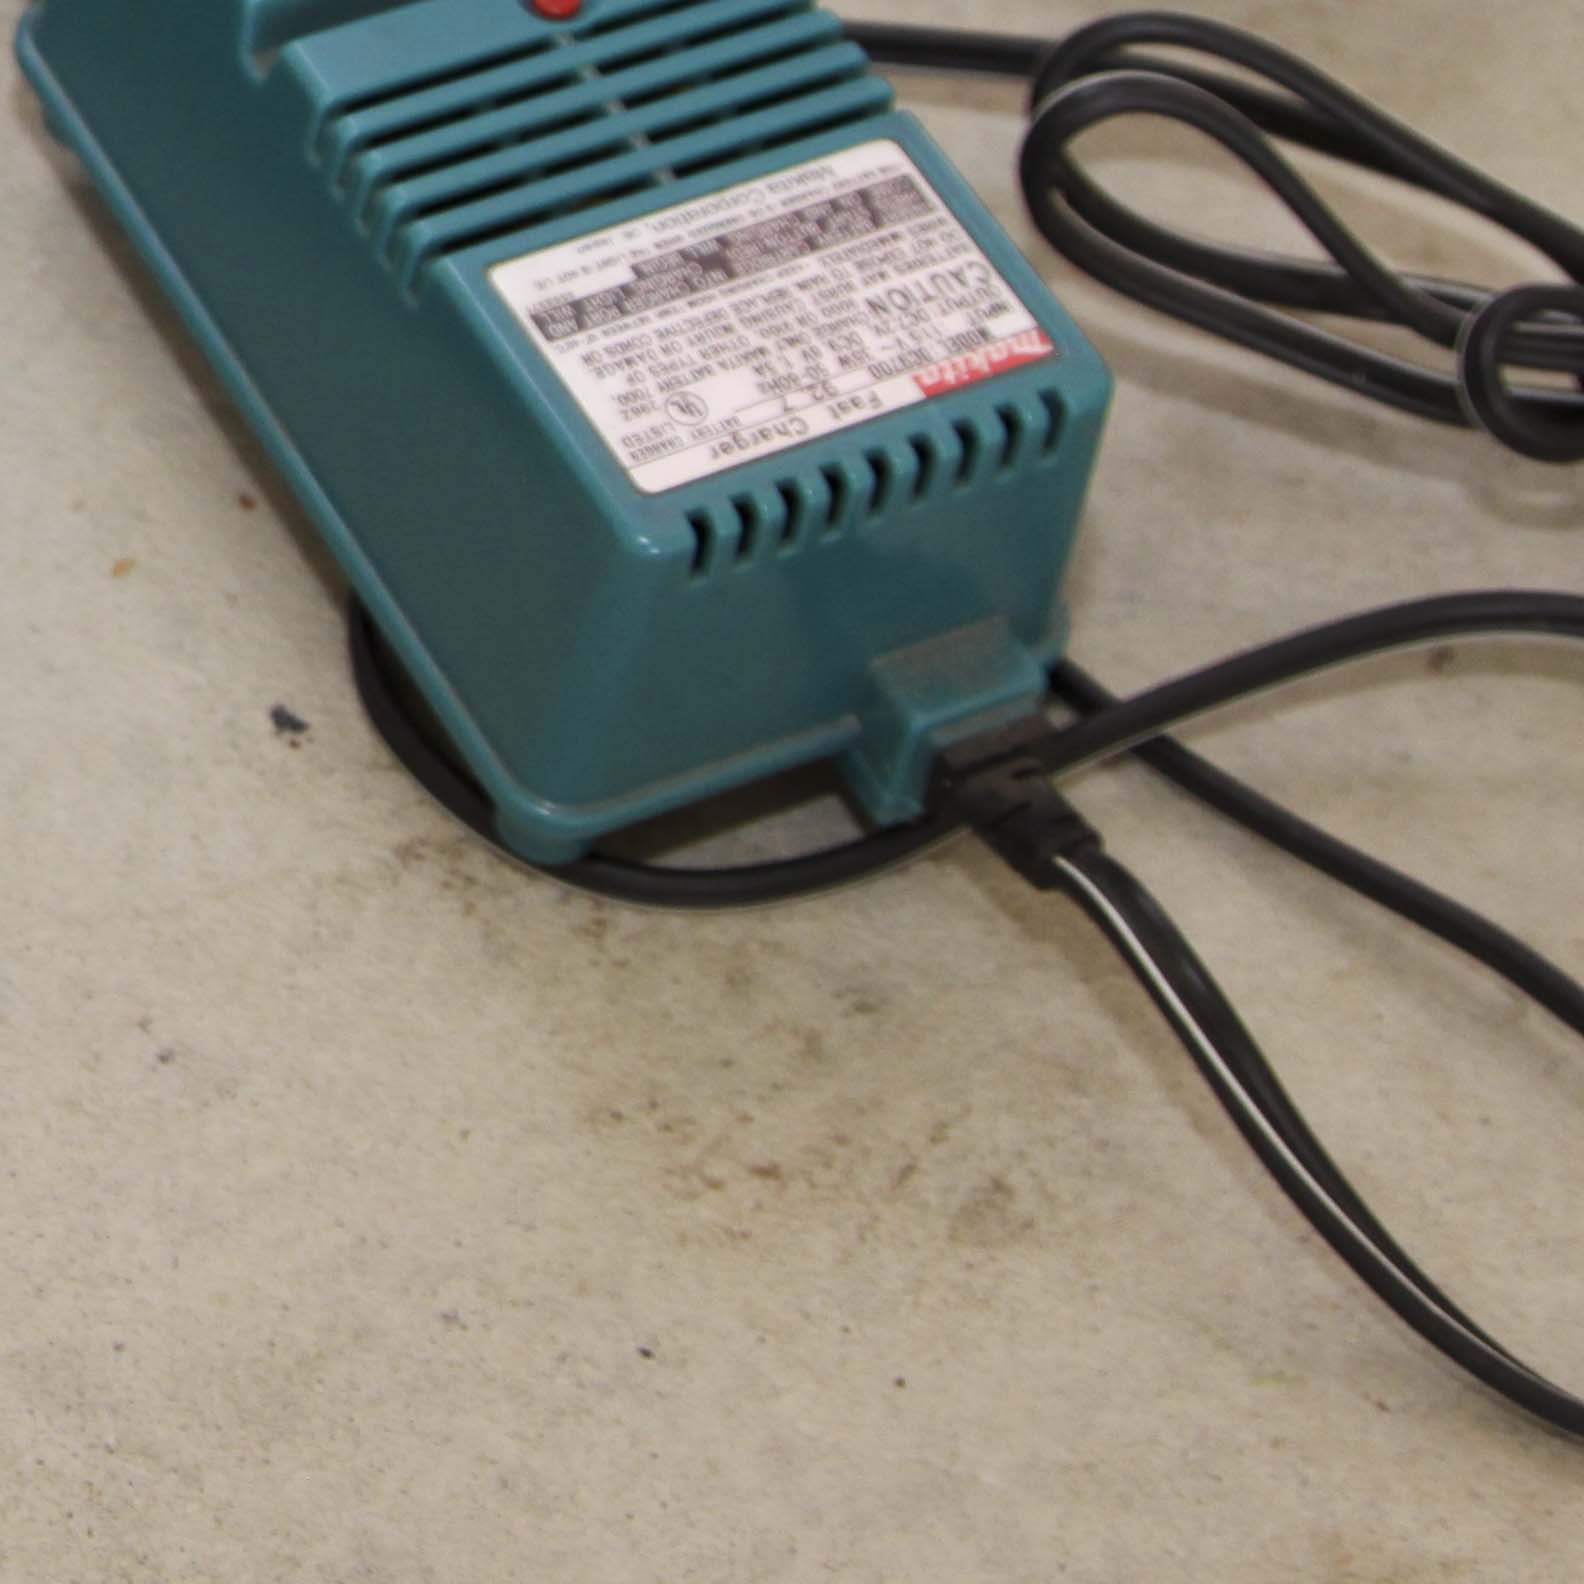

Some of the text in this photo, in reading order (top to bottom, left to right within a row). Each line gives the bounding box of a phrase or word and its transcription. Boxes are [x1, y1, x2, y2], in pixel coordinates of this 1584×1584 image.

[862, 258, 997, 320] CAUTION
[695, 333, 753, 362] OTHER
[937, 324, 996, 355] MODEL
[645, 352, 699, 379] TYPES
[824, 388, 886, 422] Fast
[617, 419, 678, 450] LISTED
[699, 409, 812, 465] Charger
